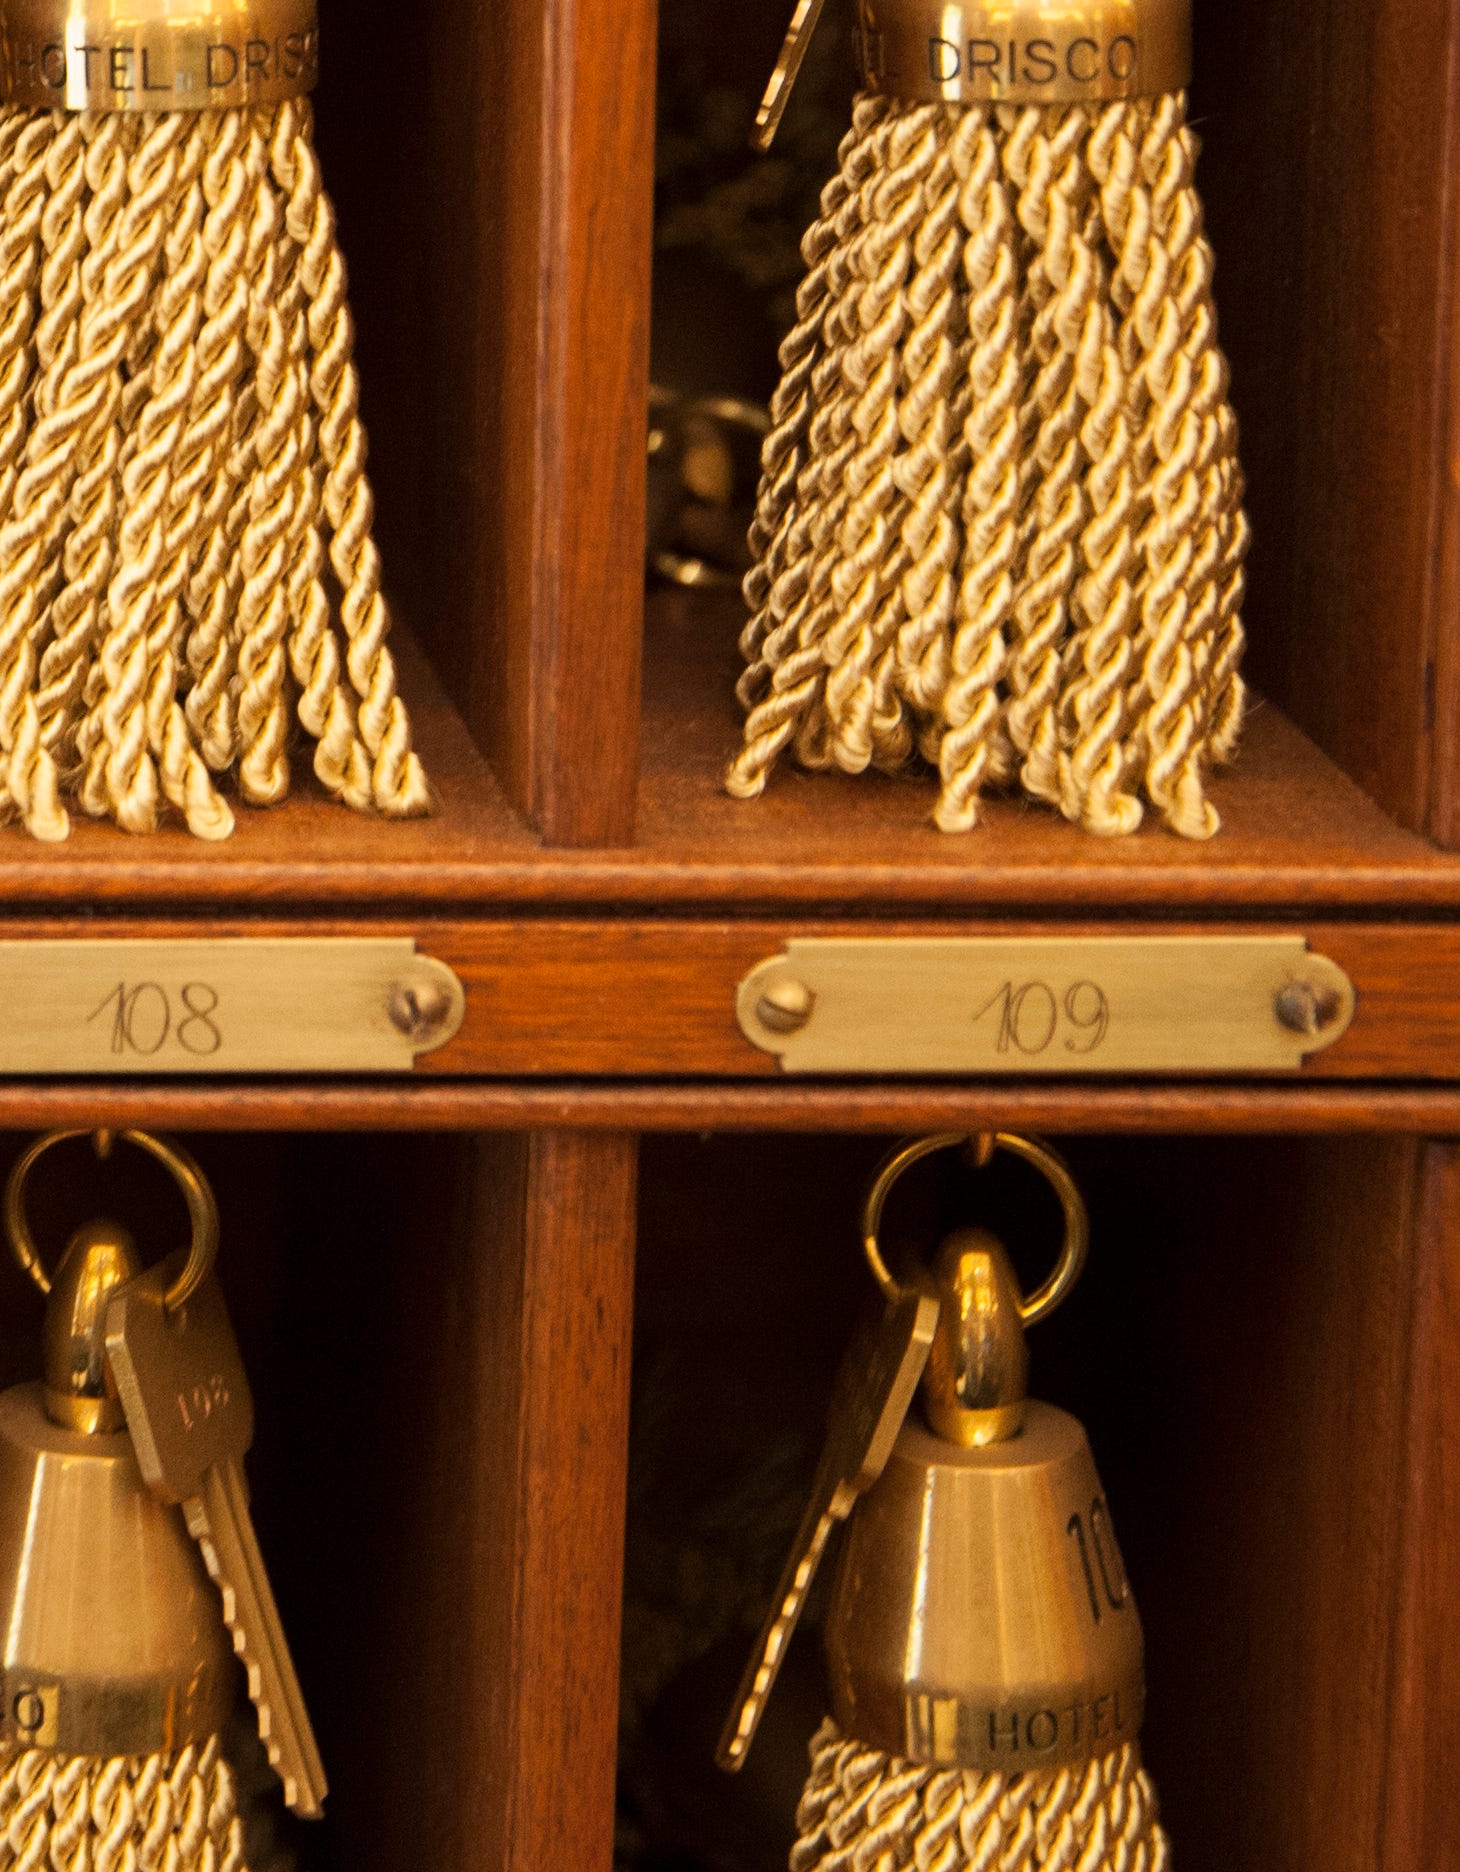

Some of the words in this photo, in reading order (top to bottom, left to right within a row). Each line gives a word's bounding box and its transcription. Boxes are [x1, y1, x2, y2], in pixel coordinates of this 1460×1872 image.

[15, 40, 173, 93] HOTEL
[927, 35, 1139, 85] DRISCO
[86, 980, 223, 1056] 108
[972, 979, 1111, 1056] 109
[987, 1690, 1125, 1753] HOTEL
